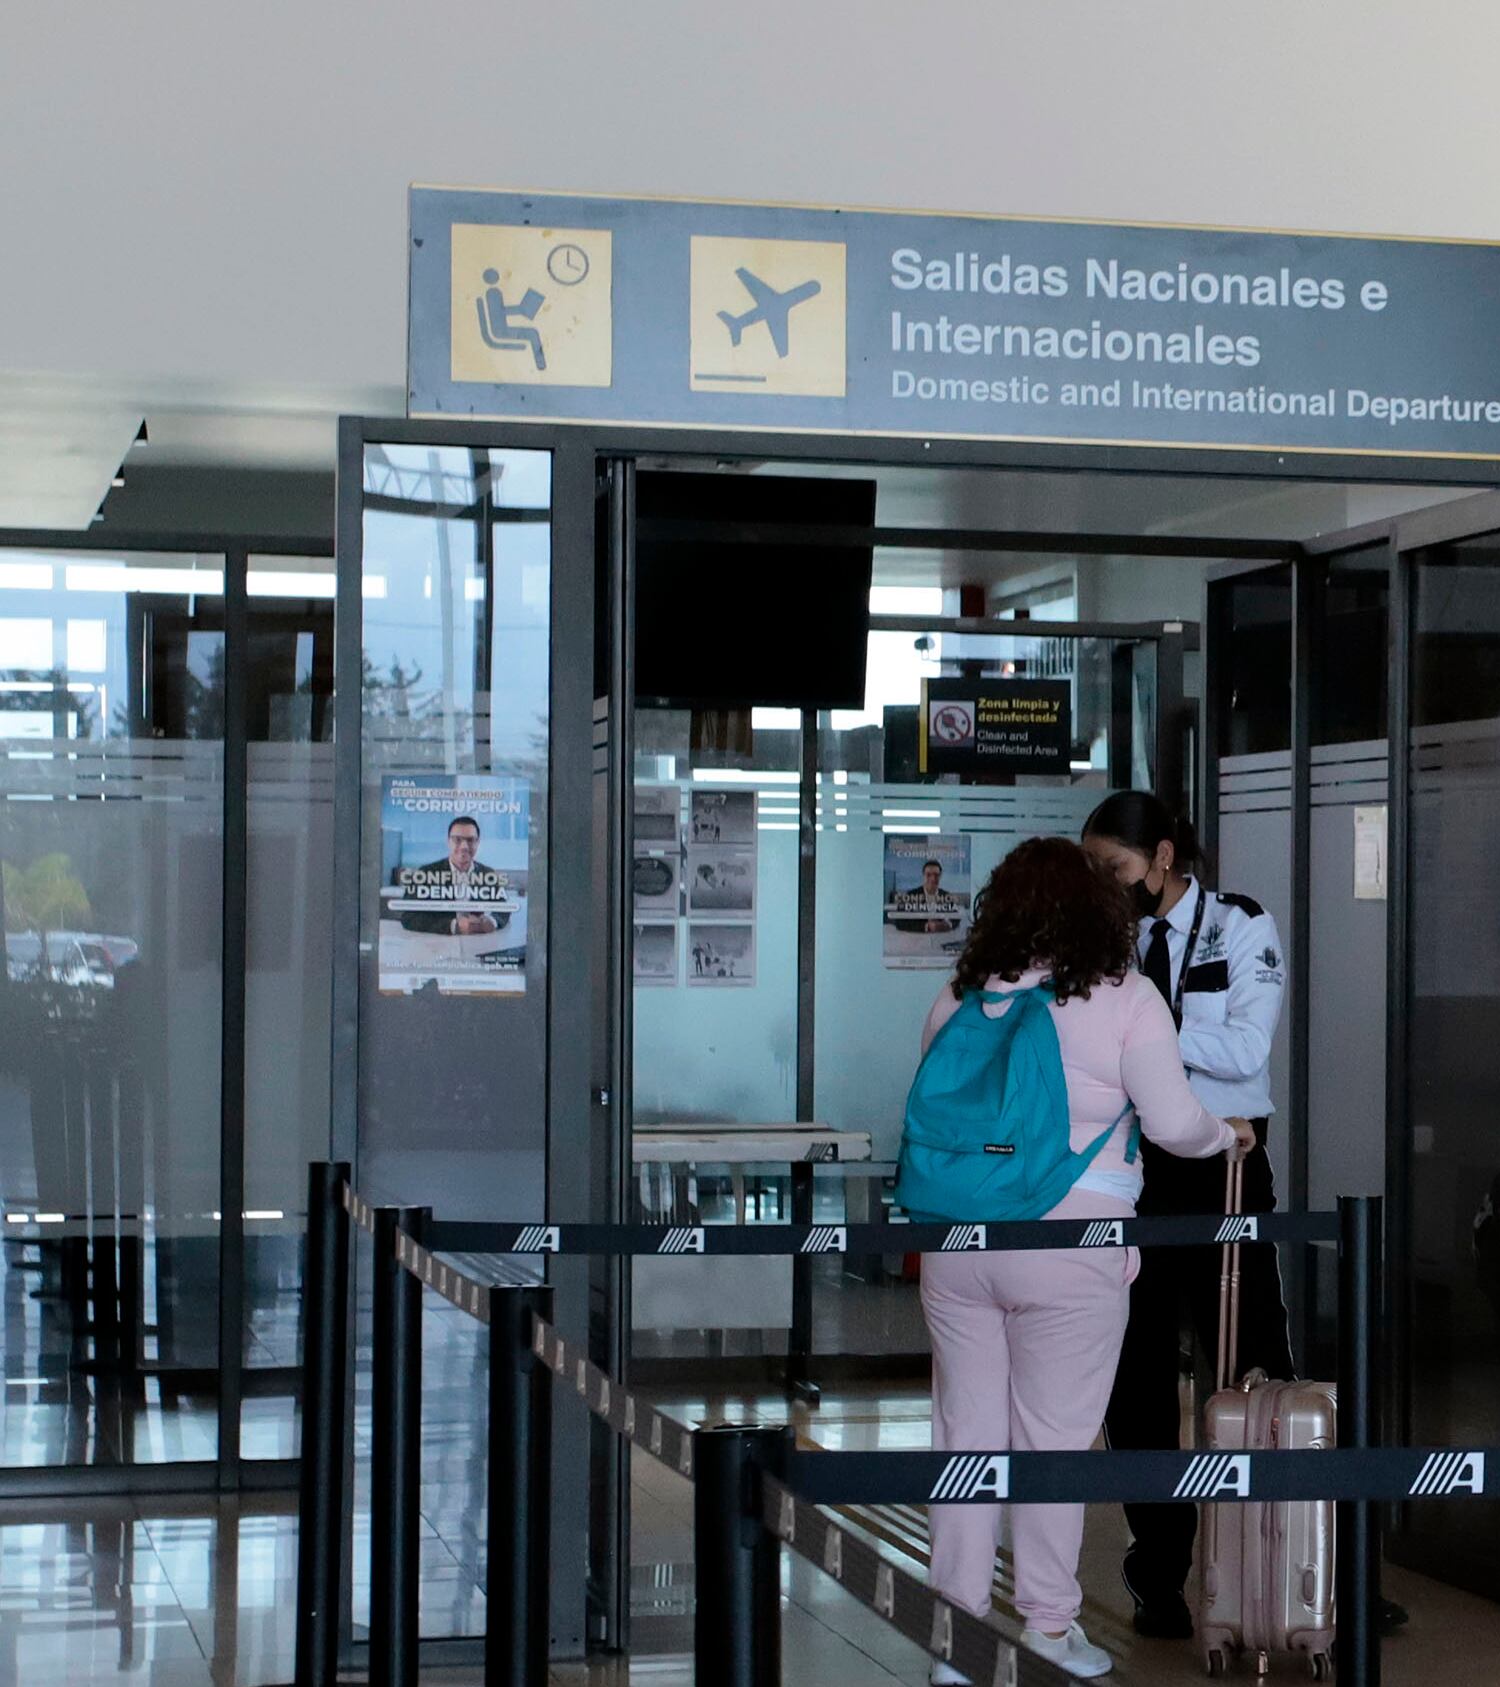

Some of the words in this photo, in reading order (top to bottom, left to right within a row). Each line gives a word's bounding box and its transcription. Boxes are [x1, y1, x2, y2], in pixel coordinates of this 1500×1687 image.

[891, 248, 1069, 297] Salidas
[1085, 258, 1346, 309] Nacionales
[1360, 280, 1388, 312] e
[891, 311, 1261, 367] Internacionales
[892, 371, 1049, 404] Domestic
[1060, 378, 1121, 407] and
[1132, 380, 1335, 416] International
[977, 698, 1008, 709] Zona
[1012, 698, 1049, 711] limpia
[1053, 700, 1060, 711] y
[978, 711, 1057, 723] desinfectada
[977, 730, 1007, 741] Clean
[1010, 731, 1028, 742] and
[977, 744, 1032, 756] Disinfected
[1034, 746, 1058, 756] Area
[404, 799, 520, 813] CORRUPCION
[416, 885, 508, 900] DENUNCIA
